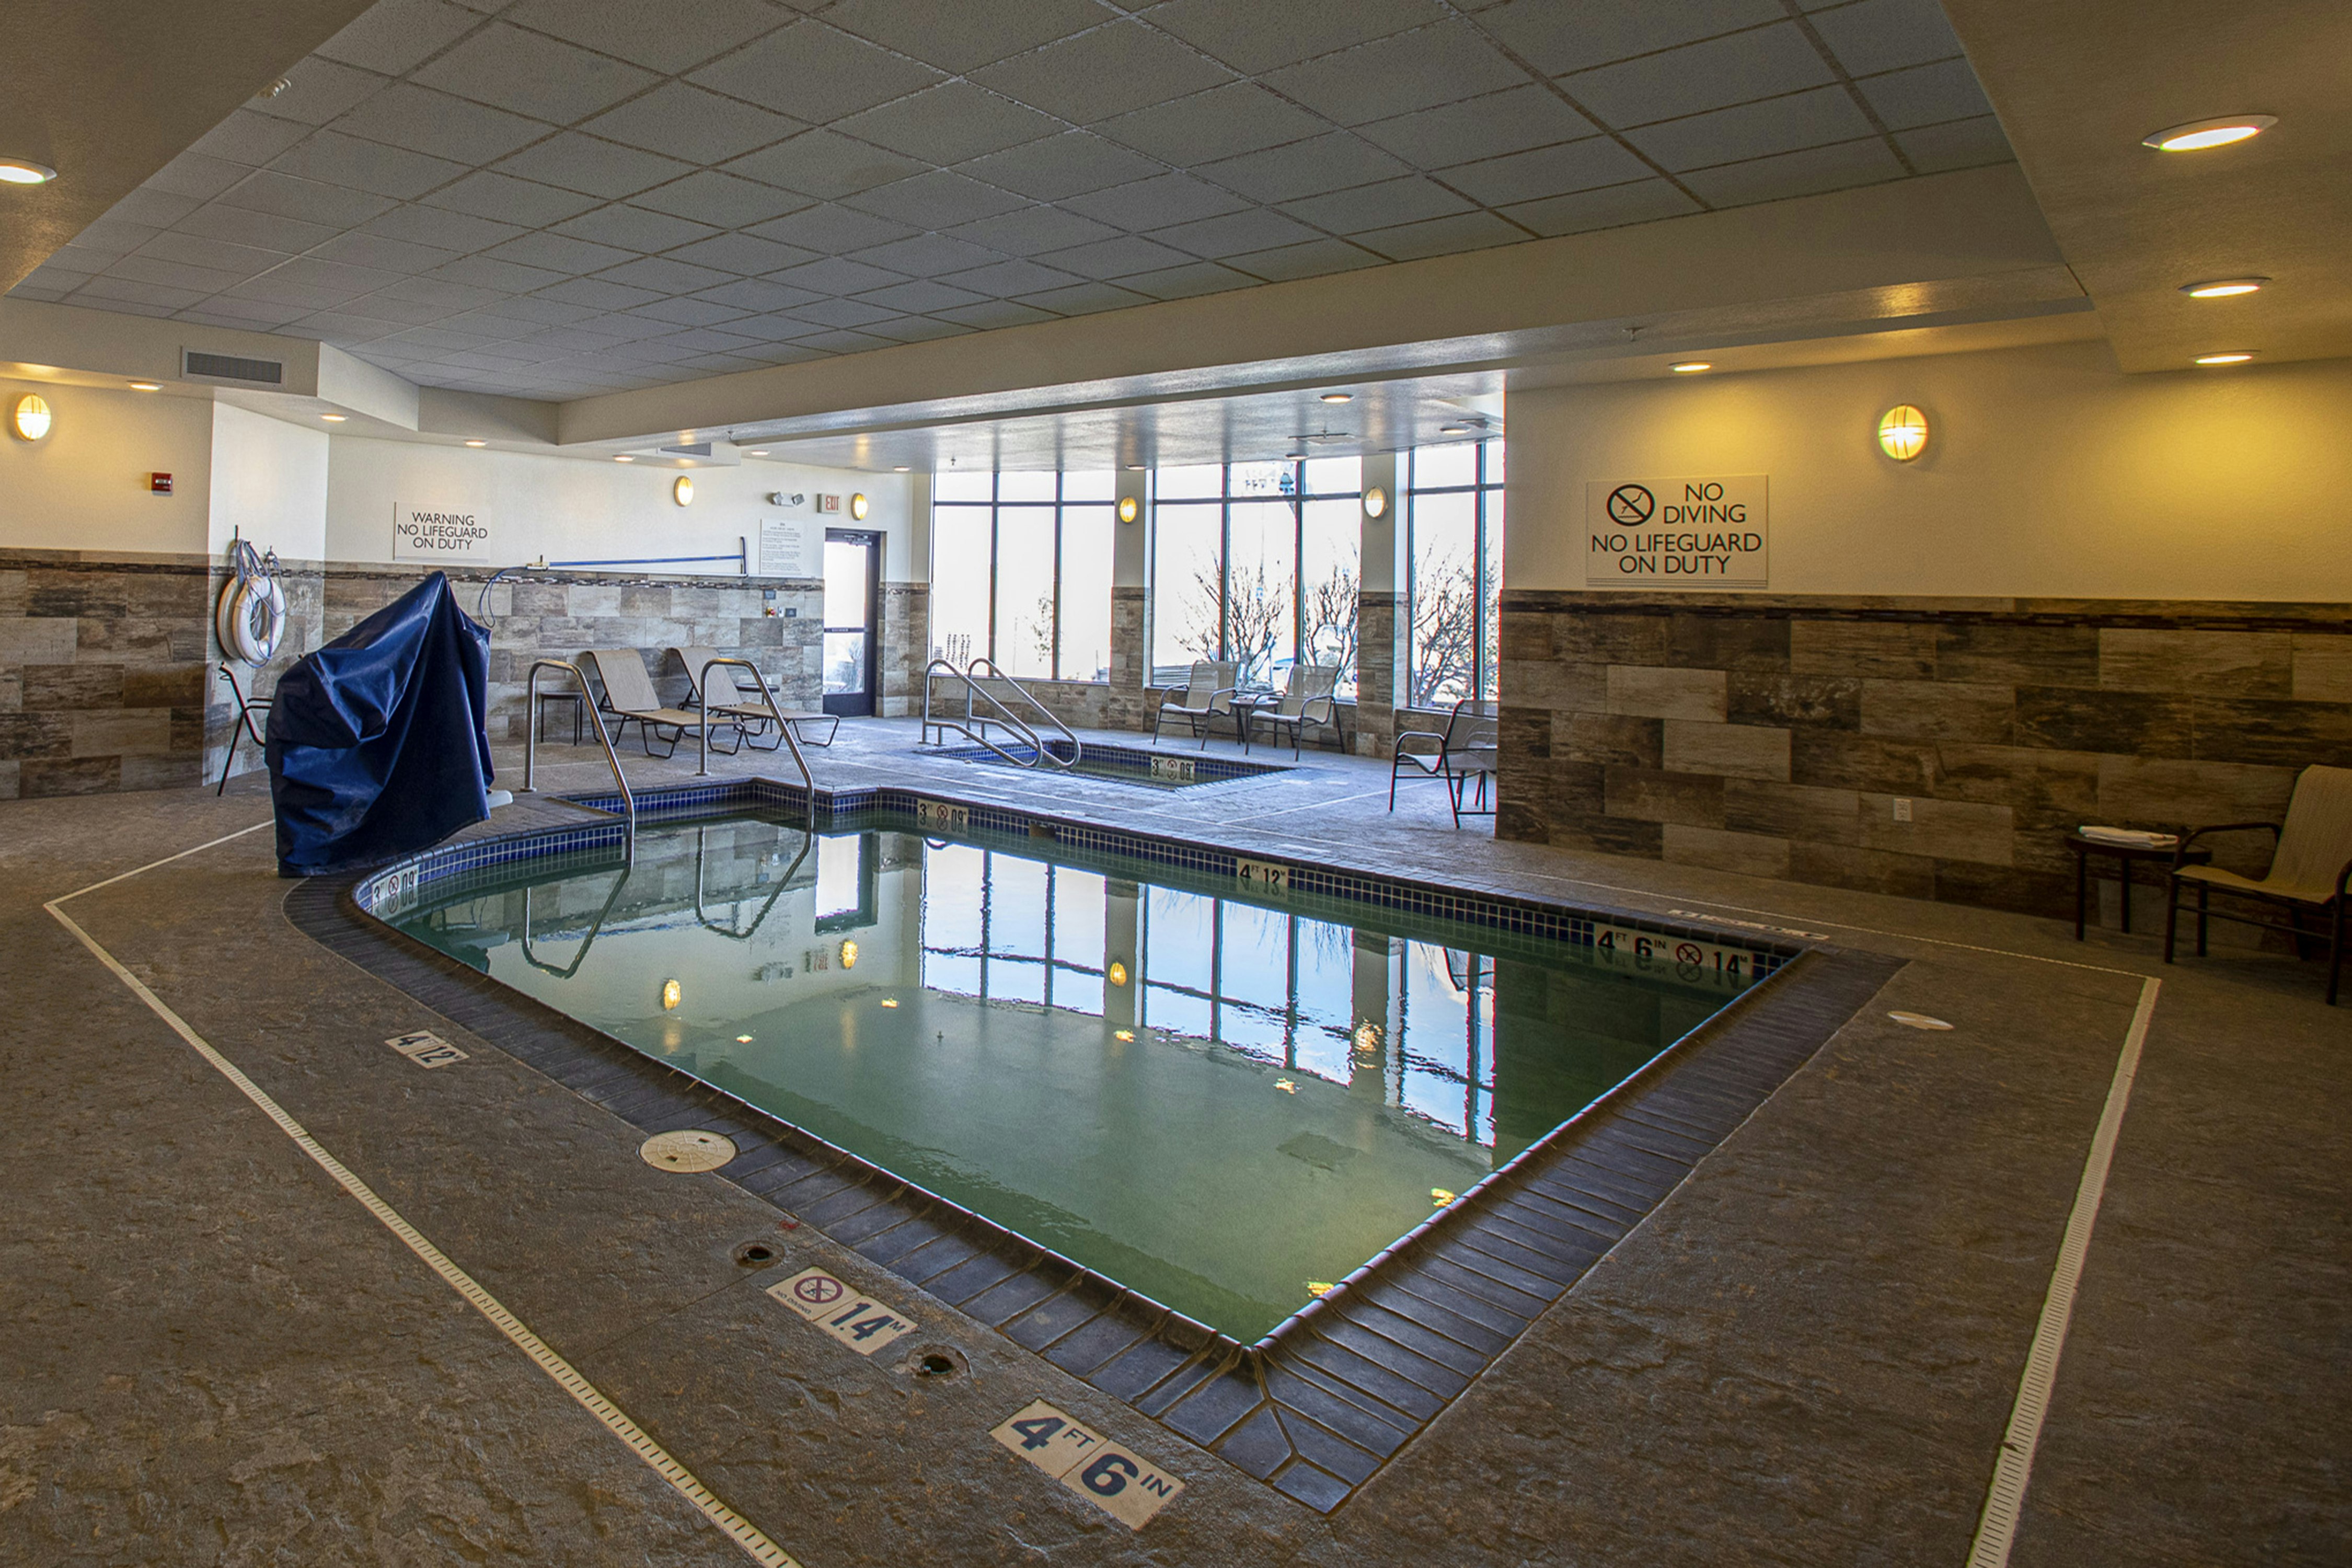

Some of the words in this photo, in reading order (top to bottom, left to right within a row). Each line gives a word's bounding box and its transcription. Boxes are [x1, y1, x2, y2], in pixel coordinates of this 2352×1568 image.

[1686, 482, 1724, 501] NO
[826, 495, 839, 511] EXIT
[412, 512, 475, 526] WARNING
[1664, 504, 1746, 524] DIVING
[398, 524, 419, 535] NO
[423, 525, 488, 538] LIFEGUARD
[413, 537, 434, 548] ON
[438, 538, 472, 550] DUTY
[1592, 534, 1628, 552] NO
[1636, 533, 1762, 552] LIFEGUARD
[1619, 555, 1655, 574] ON
[1665, 555, 1731, 574] DUTY
[1153, 759, 1159, 769] 3
[920, 803, 927, 816] 3
[1239, 864, 1251, 879] 4
[1597, 930, 1616, 949] 4
[1616, 932, 1627, 941] FT
[1635, 937, 1653, 957] 6
[1654, 940, 1667, 949] IN
[398, 1036, 430, 1046] 4
[830, 1302, 895, 1342] 1.4
[889, 1321, 906, 1332] M
[1010, 1416, 1067, 1451] 4
[1063, 1427, 1096, 1448] FT
[1081, 1453, 1139, 1497] 6
[1140, 1473, 1173, 1498] IN
